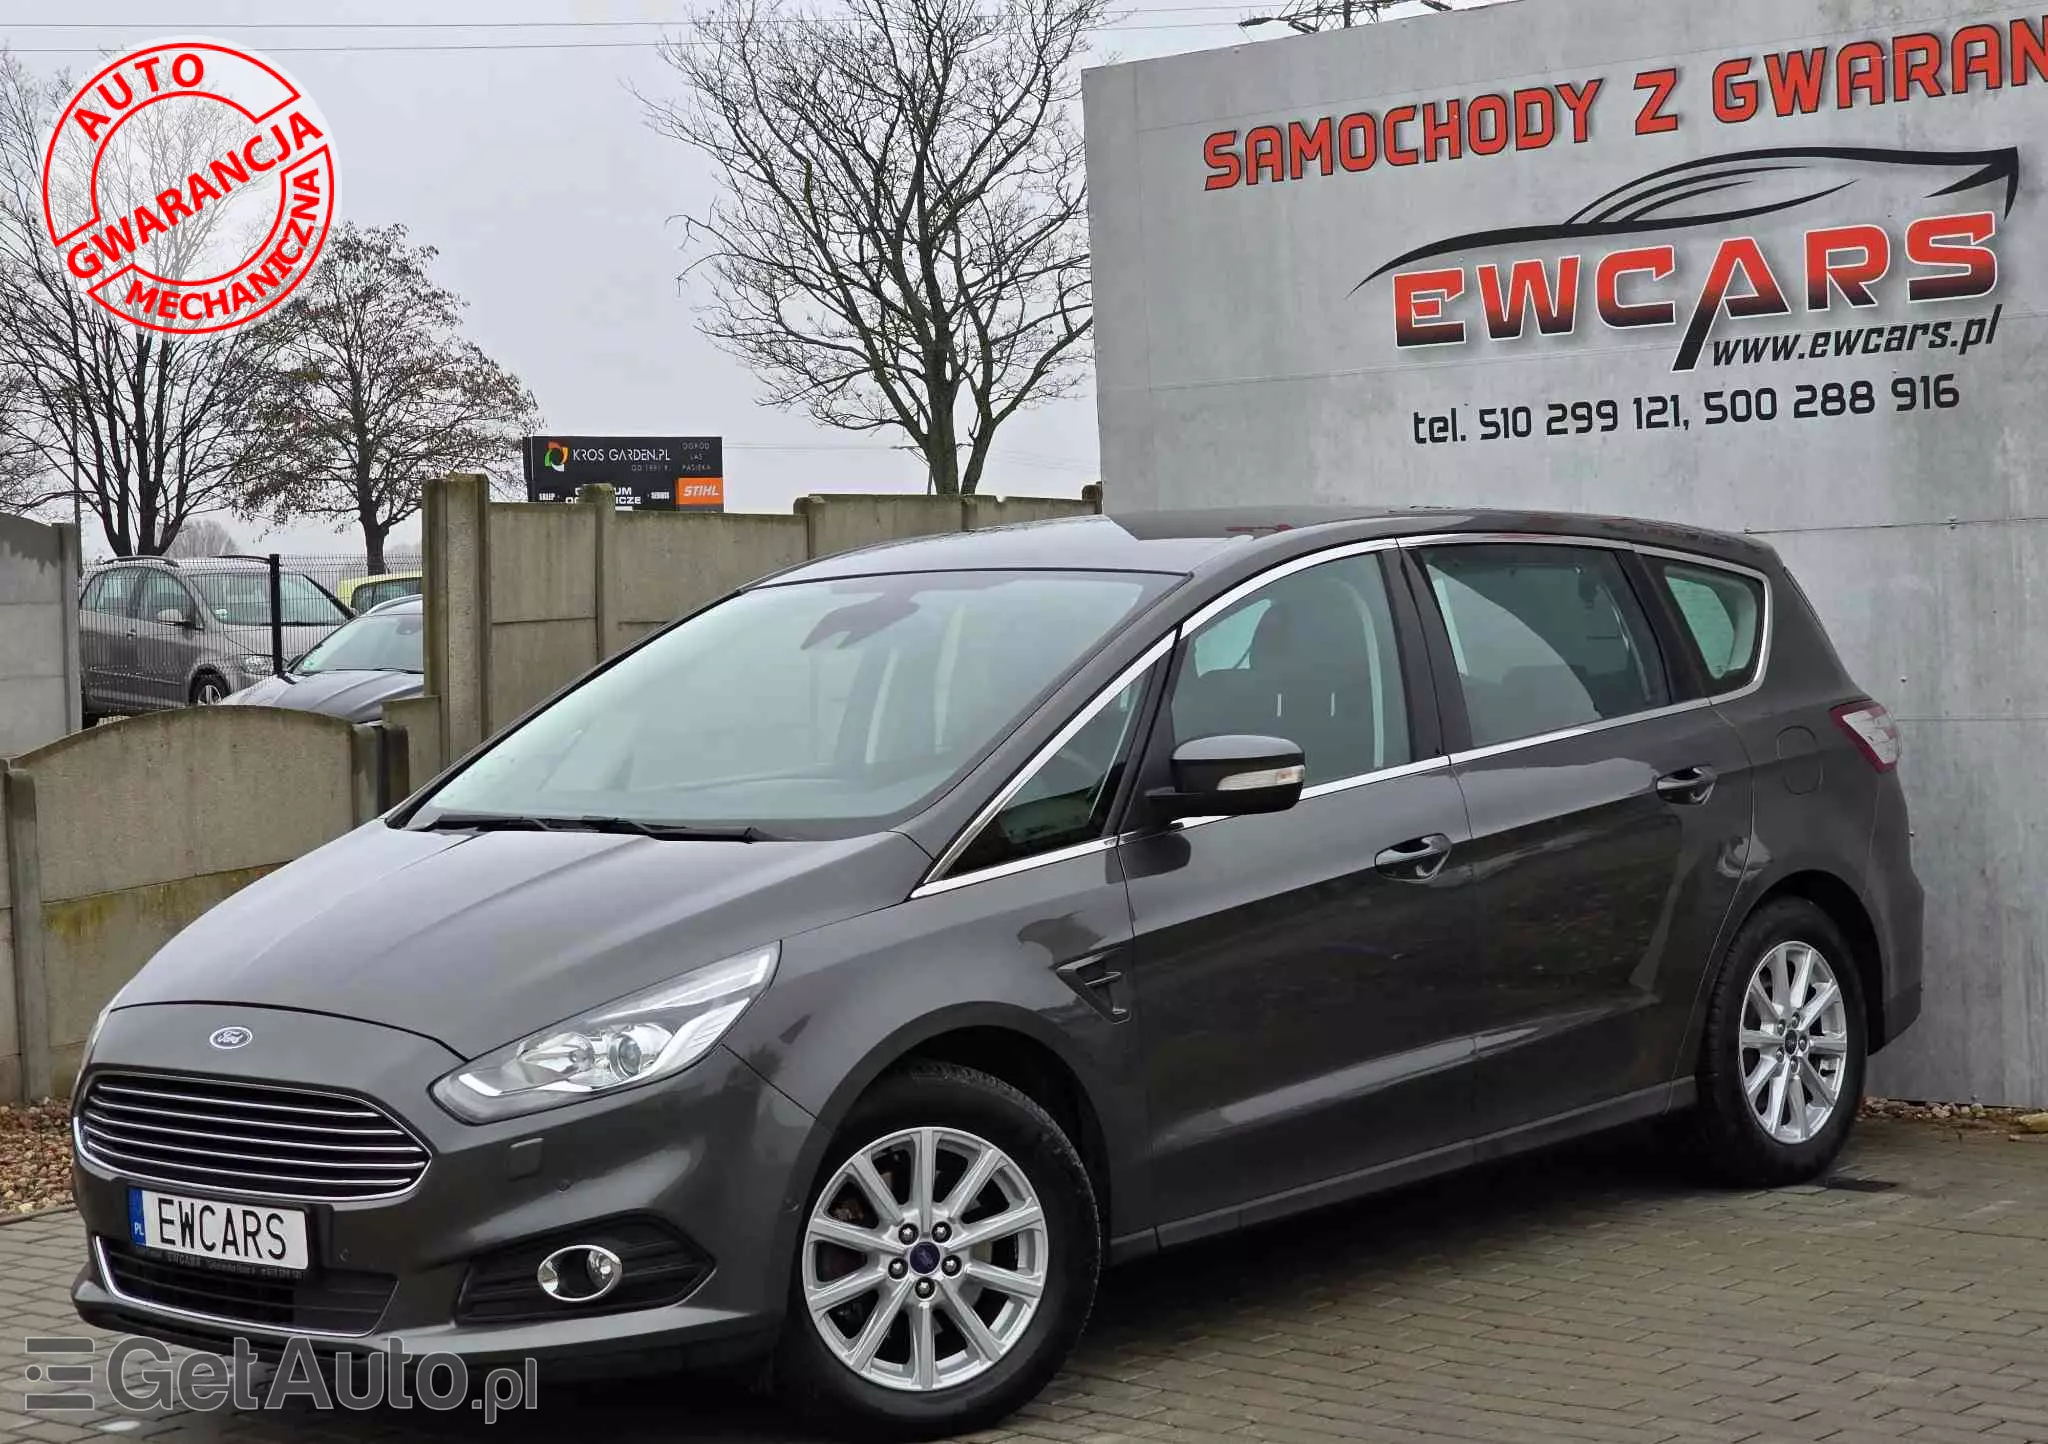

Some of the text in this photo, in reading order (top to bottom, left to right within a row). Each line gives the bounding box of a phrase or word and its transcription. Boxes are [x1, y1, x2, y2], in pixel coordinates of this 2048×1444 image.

[1203, 15, 2048, 191] SAMOCHODY Z GWARAN
[1392, 212, 1998, 372] EWCARS
[1712, 303, 2003, 366] www.ewcars.pl
[1413, 373, 1960, 444] tel. 510 299 121, 500 288 916
[573, 448, 671, 461] KROS GARDEN.PL
[683, 485, 720, 497] STIHL
[134, 1221, 145, 1236] PL
[158, 1197, 287, 1260] EWCARS
